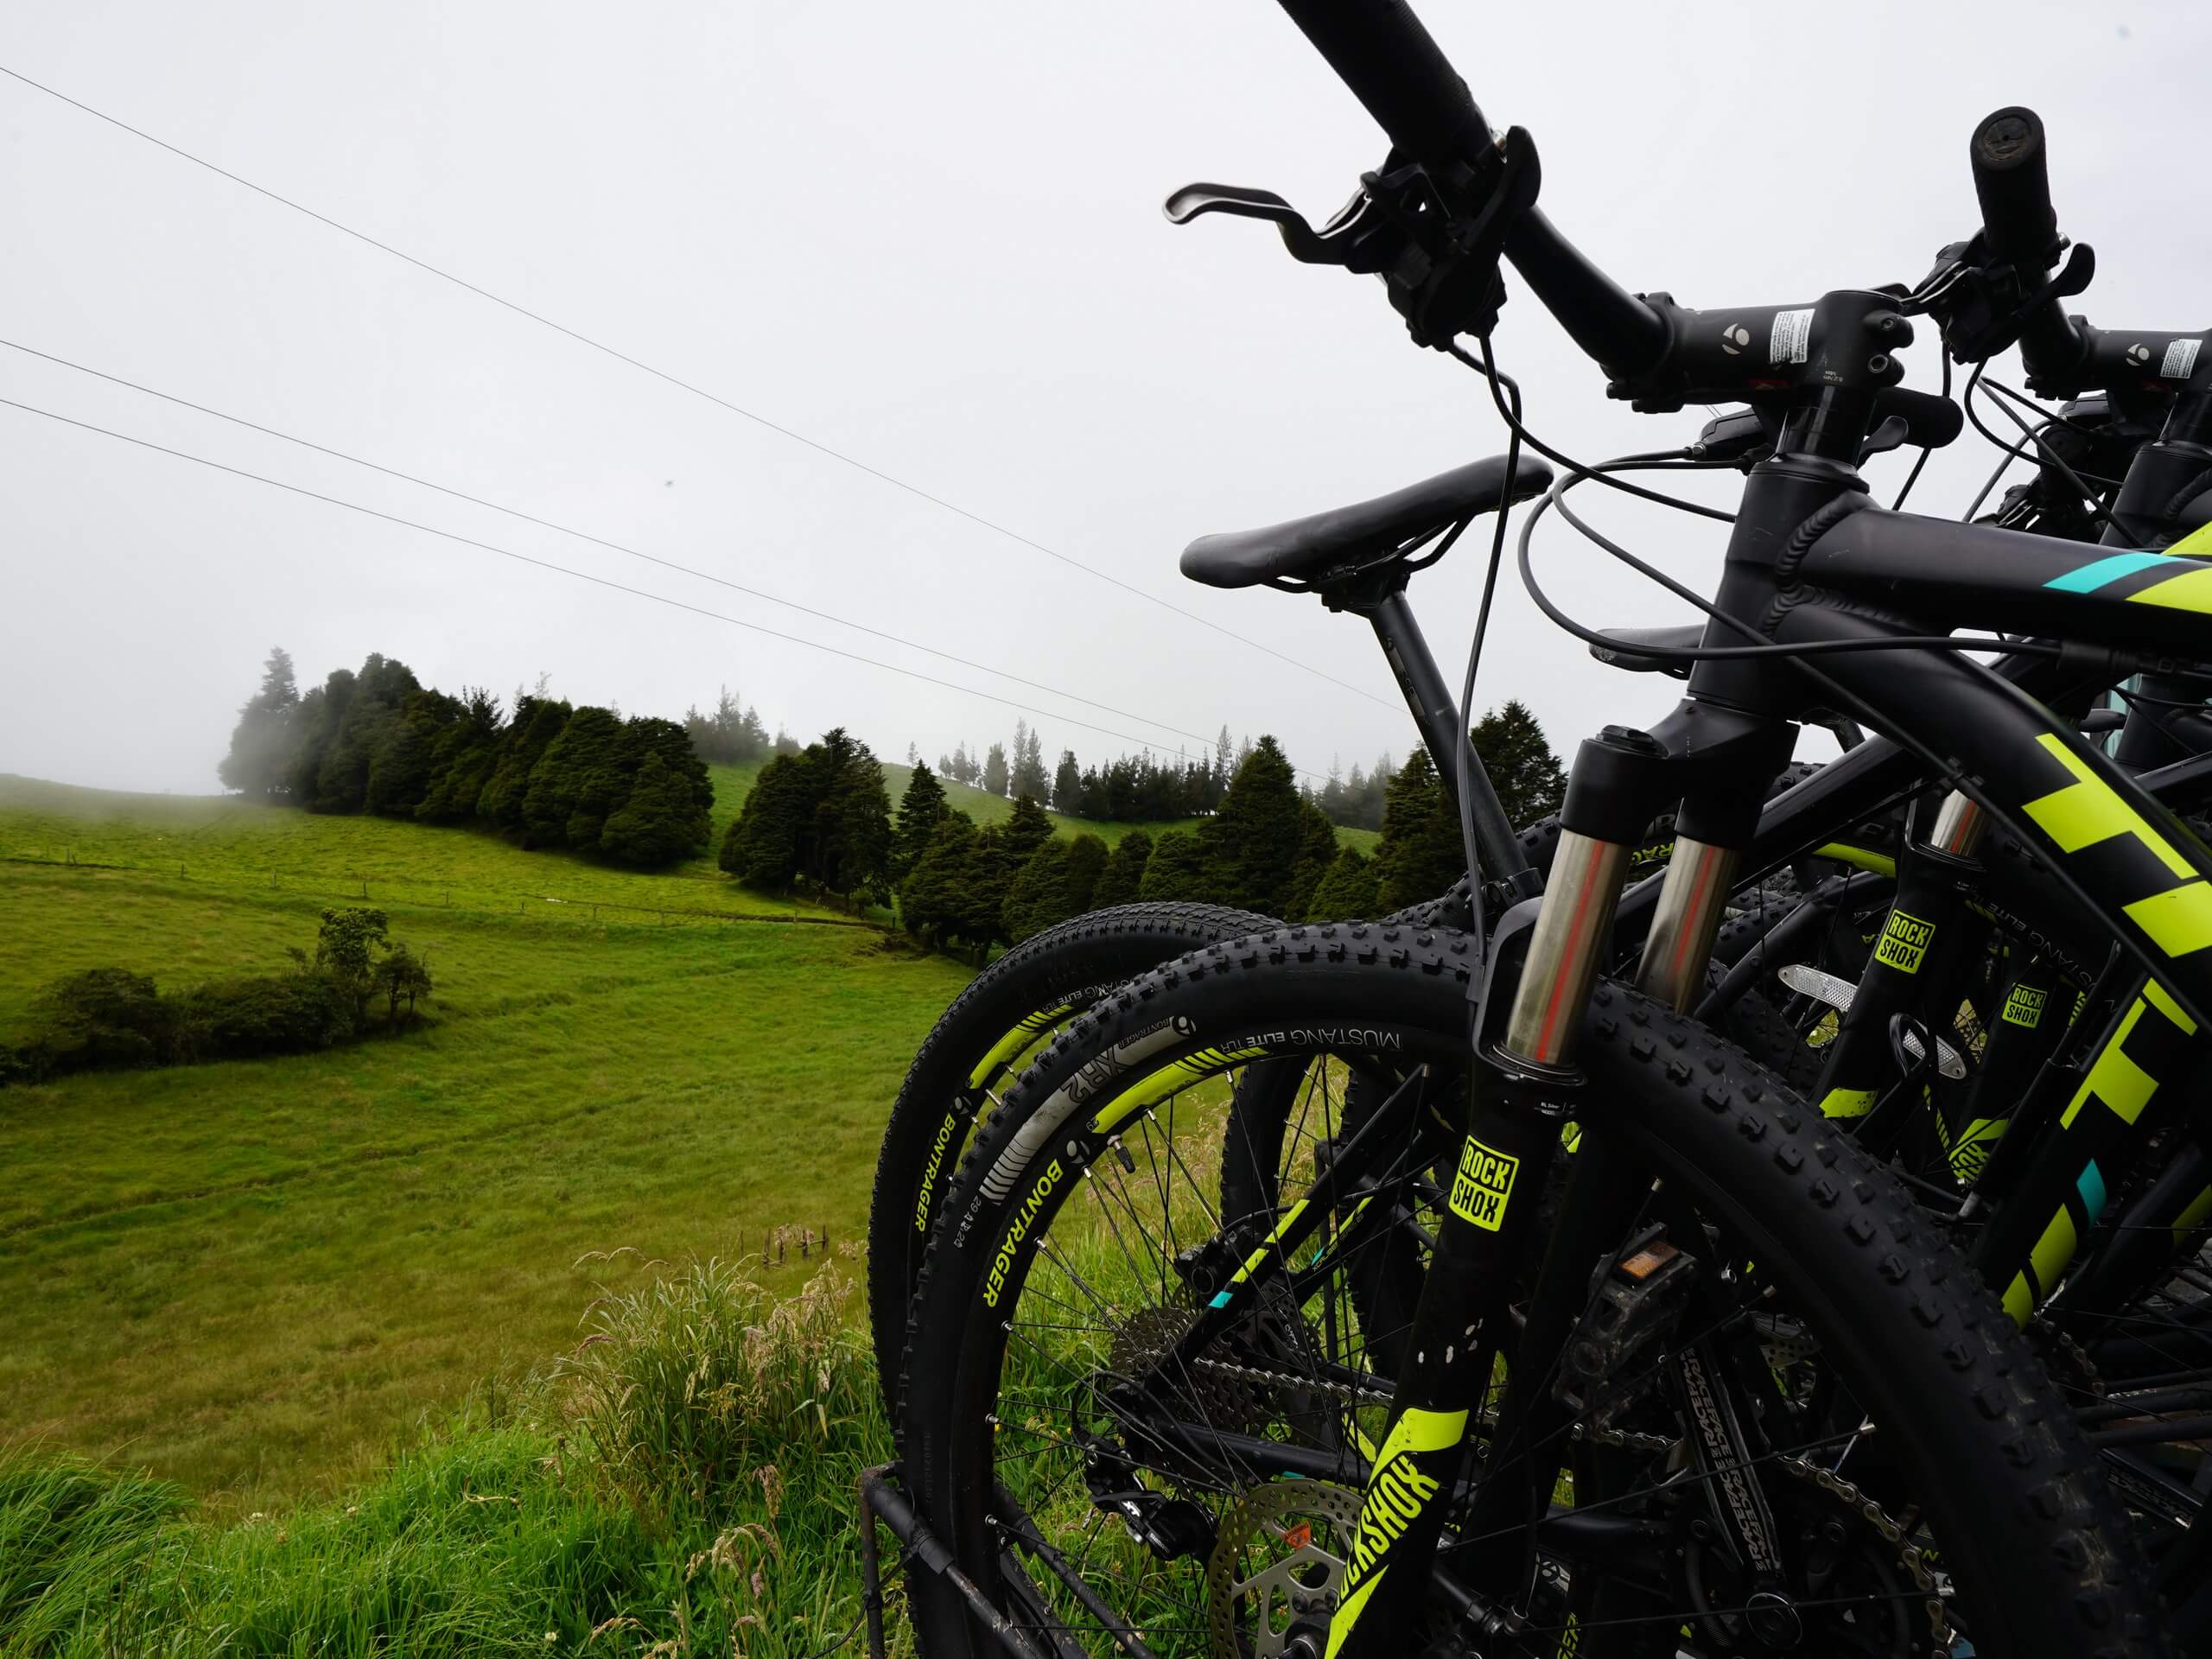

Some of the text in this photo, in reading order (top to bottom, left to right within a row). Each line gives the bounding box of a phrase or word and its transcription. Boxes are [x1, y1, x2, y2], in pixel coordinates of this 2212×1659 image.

[1887, 915, 1929, 946] ROCK
[1880, 938, 1919, 969] SHOX
[1057, 989, 1082, 1006] ELITE
[2012, 988, 2044, 1010] ROCK
[2006, 1004, 2039, 1025] SHOX
[1118, 1017, 1170, 1049] BONTRAGER
[1219, 1027, 1401, 1053] MUSTANG ELITE TLR
[1058, 1046, 1132, 1104] XR2
[915, 1112, 957, 1232] BONTRAGER
[1461, 1143, 1511, 1191] ROCK
[1452, 1178, 1500, 1224] SHOX
[982, 1158, 1065, 1308] BONTRAGER
